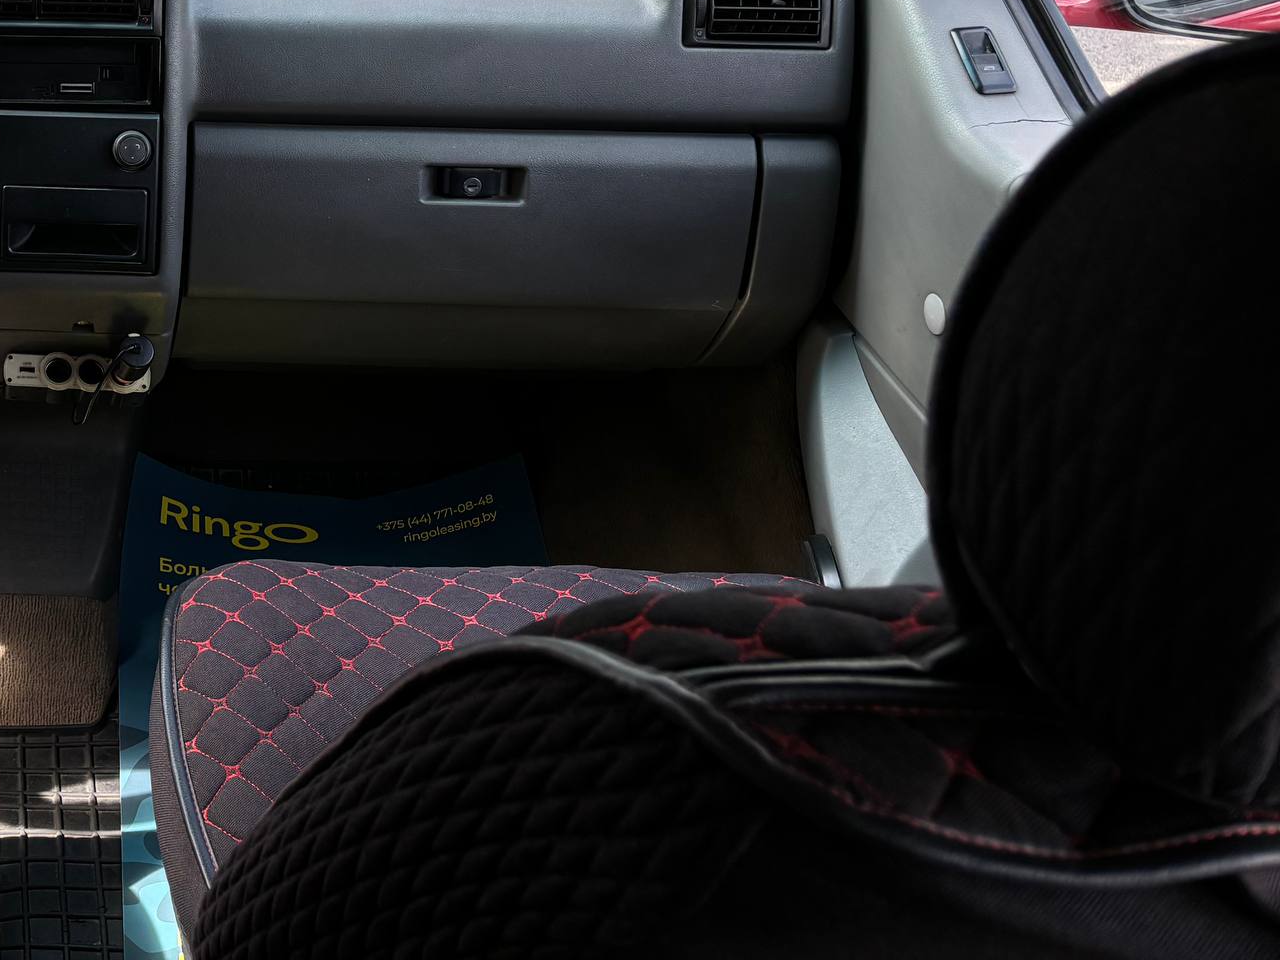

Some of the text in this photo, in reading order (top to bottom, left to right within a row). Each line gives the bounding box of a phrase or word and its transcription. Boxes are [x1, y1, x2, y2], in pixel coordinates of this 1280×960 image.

[376, 494, 494, 531] +375 (44) 771-08-48
[403, 510, 497, 543] ringoleasing.by
